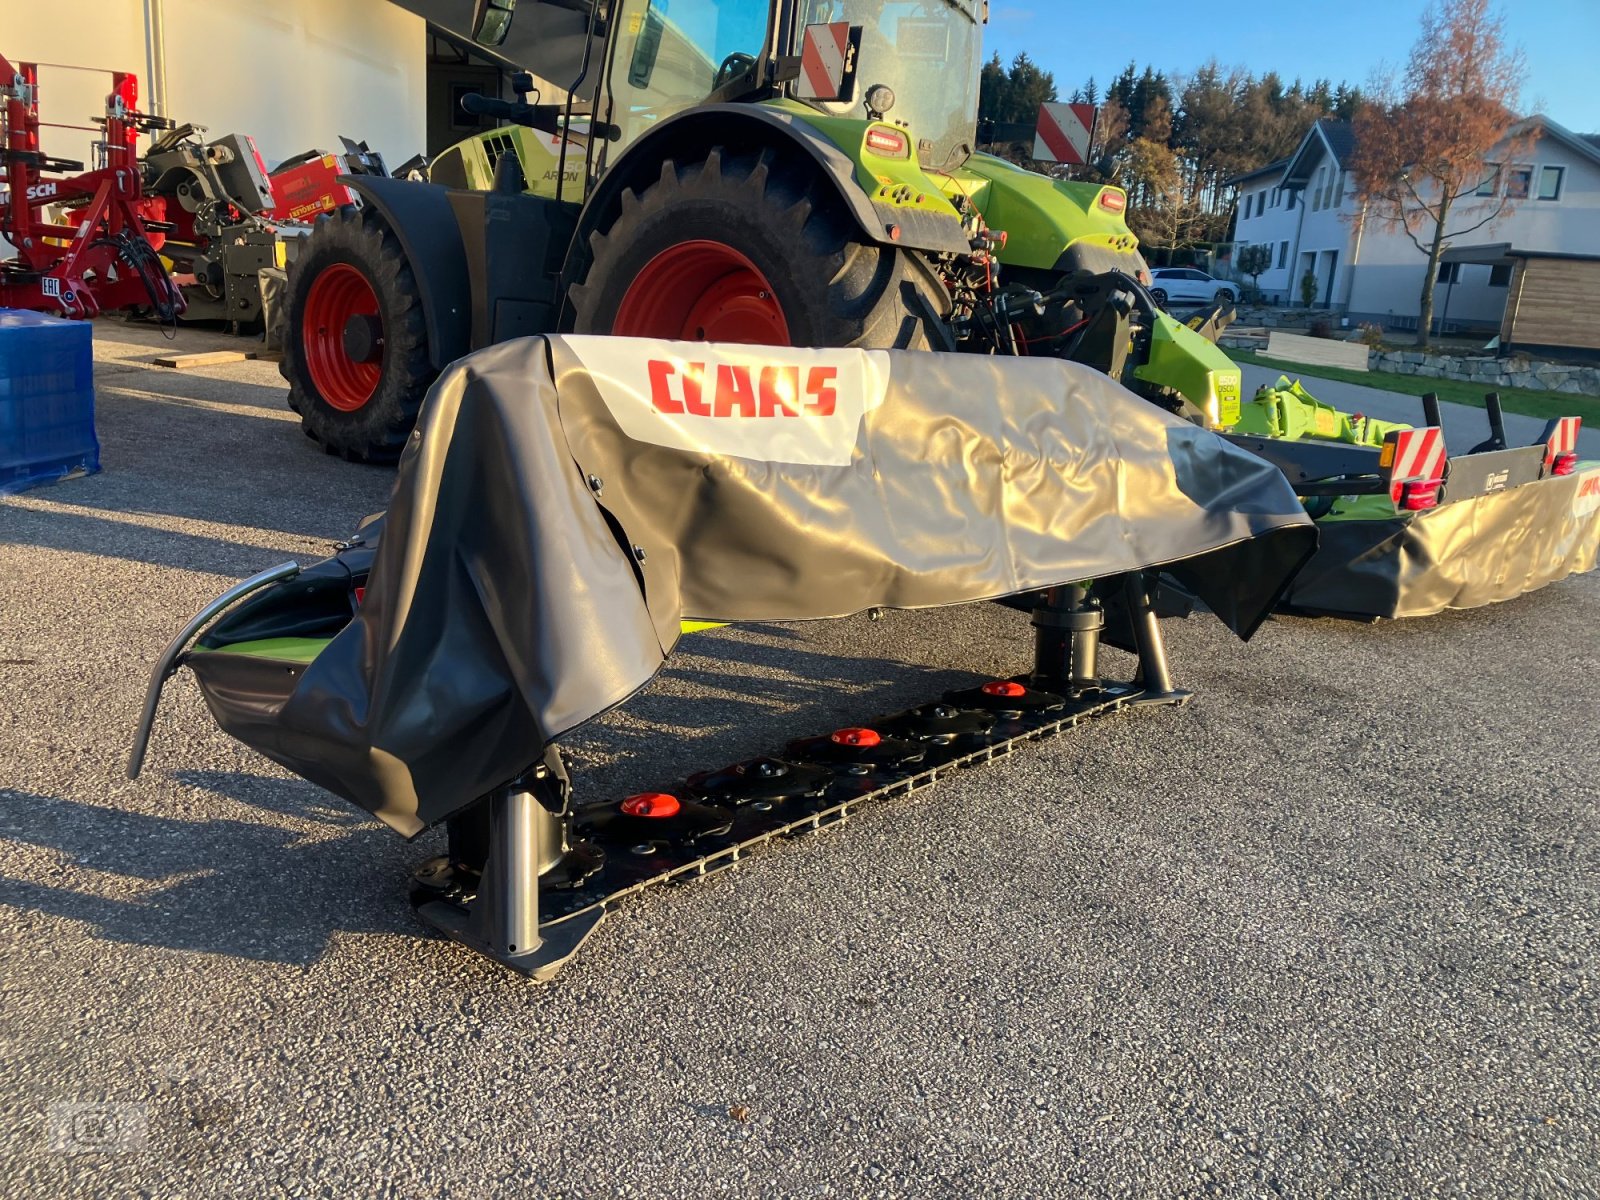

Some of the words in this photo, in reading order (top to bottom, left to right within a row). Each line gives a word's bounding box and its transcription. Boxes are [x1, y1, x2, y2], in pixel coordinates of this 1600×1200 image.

[543, 170, 579, 182] ARON
[43, 278, 58, 295] EAC
[648, 359, 837, 417] CLAAS
